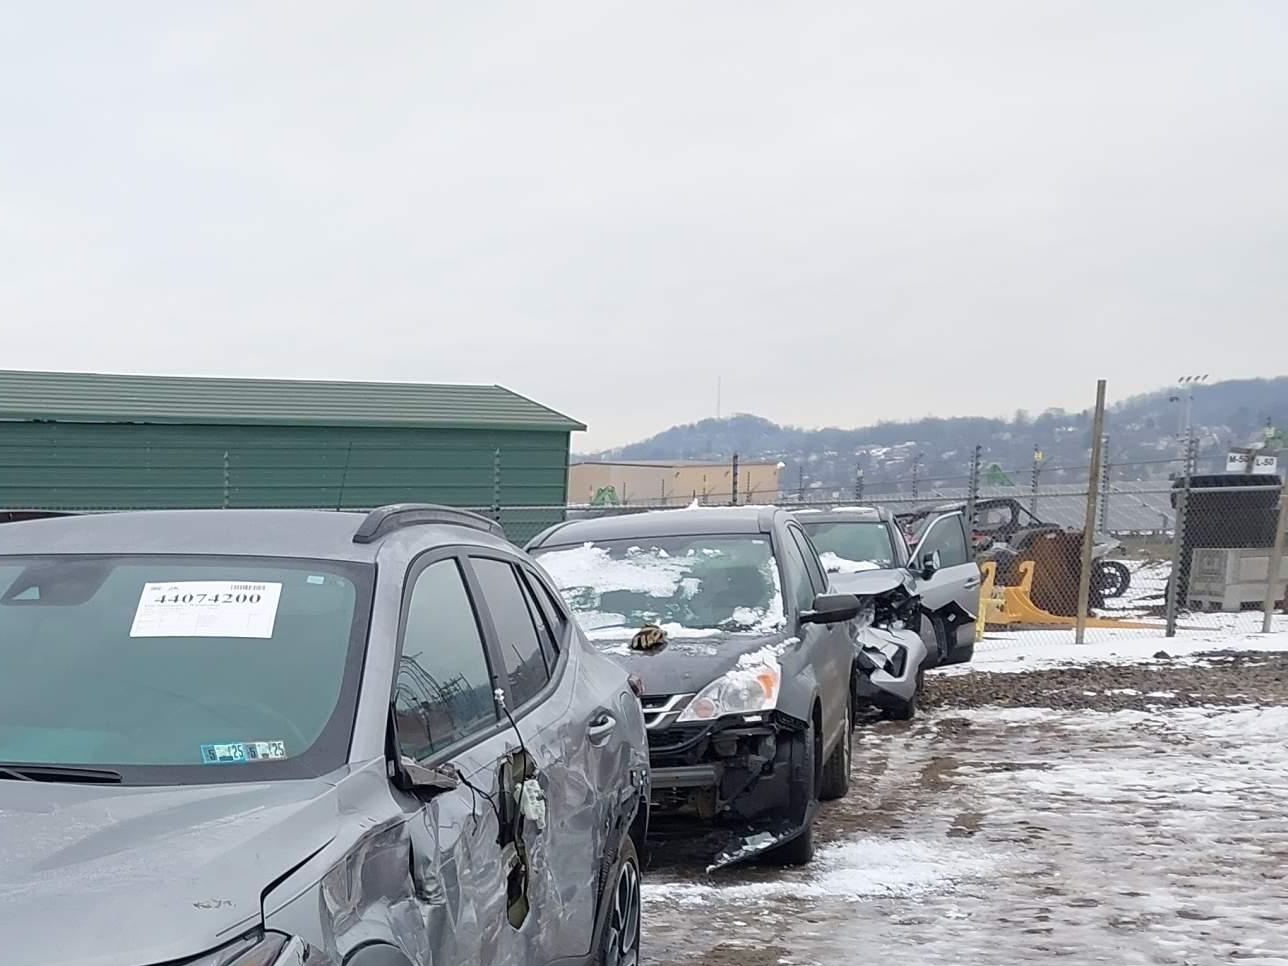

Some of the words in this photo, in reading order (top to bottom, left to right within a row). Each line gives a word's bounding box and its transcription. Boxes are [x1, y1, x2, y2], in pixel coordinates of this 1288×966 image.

[154, 593, 263, 604] 44074200
[231, 744, 245, 759] 25
[272, 742, 285, 758] 25
